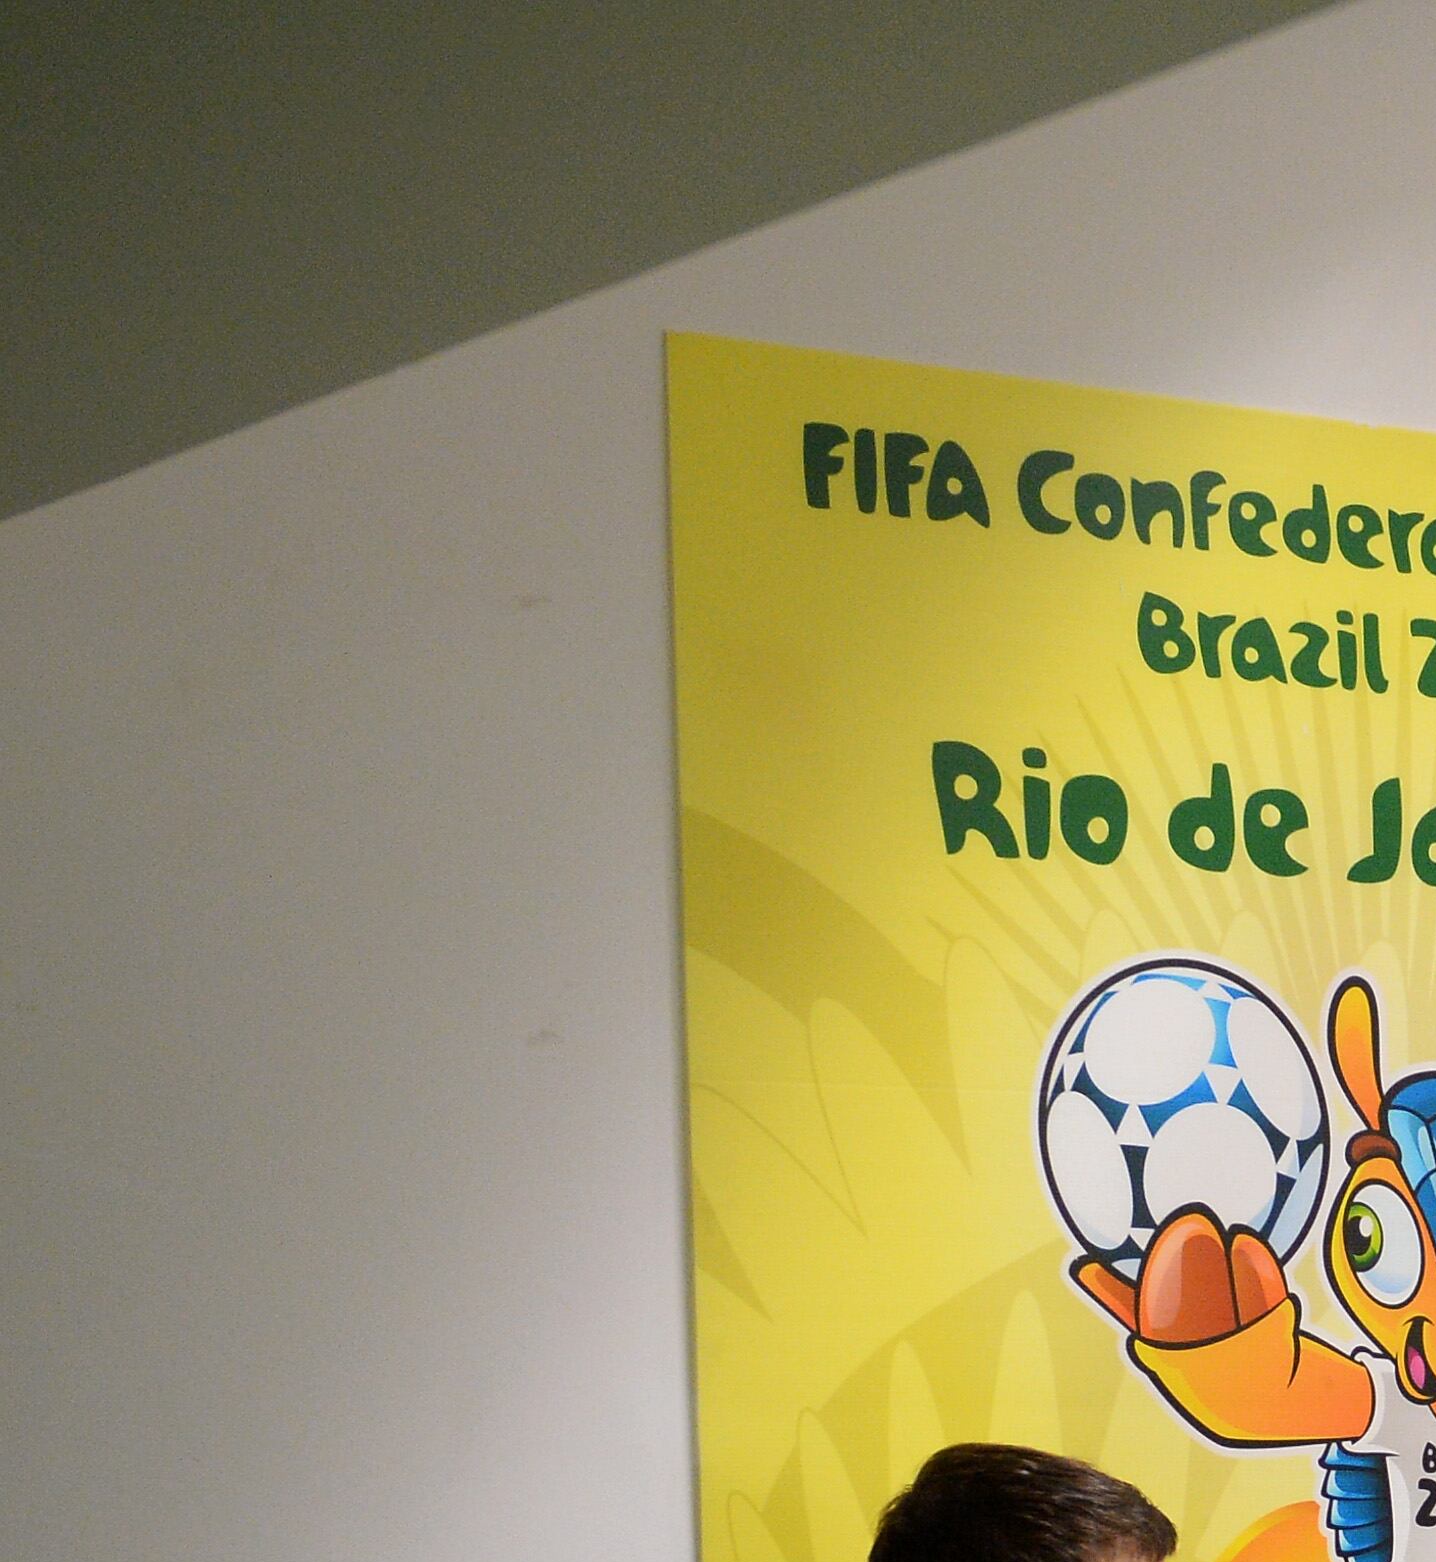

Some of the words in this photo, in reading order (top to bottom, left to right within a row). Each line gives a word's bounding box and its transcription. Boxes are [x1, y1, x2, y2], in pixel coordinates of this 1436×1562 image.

[800, 420, 991, 529] FIFA
[1136, 591, 1389, 694] Brazil
[930, 740, 1129, 866] Rio
[1167, 762, 1309, 878] de
